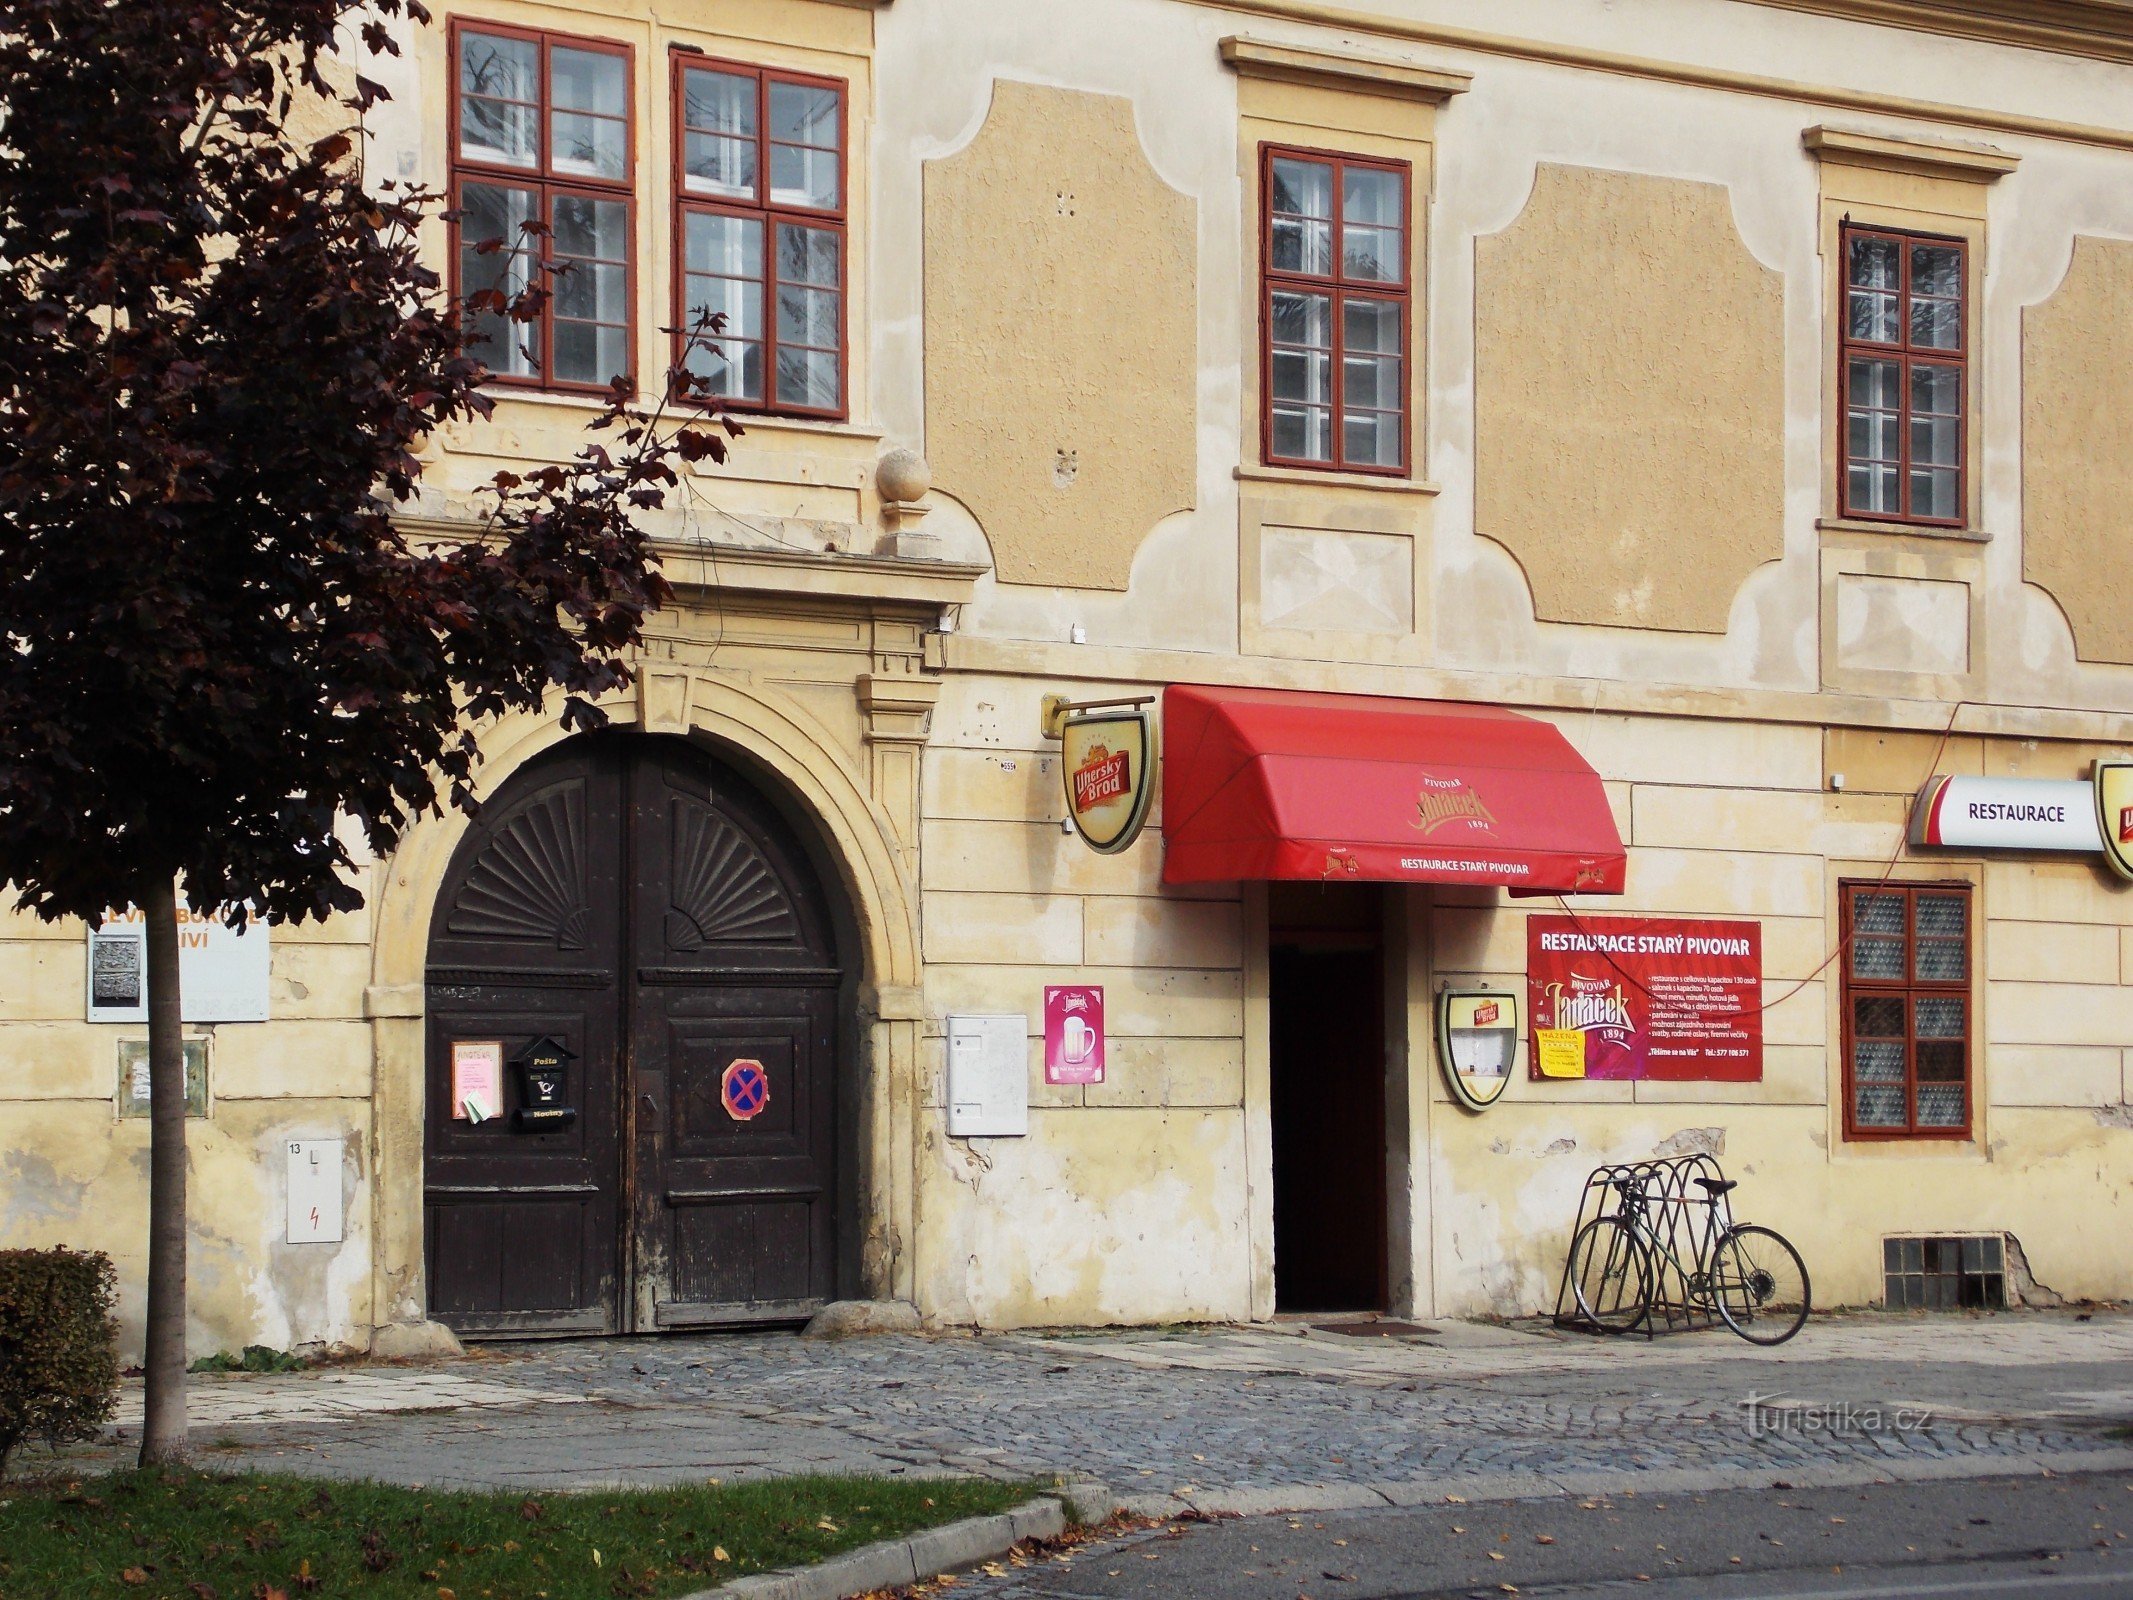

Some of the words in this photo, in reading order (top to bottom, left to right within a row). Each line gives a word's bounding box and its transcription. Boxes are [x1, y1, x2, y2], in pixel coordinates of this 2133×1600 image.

[1076, 758, 1122, 795] Uherský
[1087, 773, 1120, 801] Brod
[1424, 778, 1462, 789] PIVOVAR
[1968, 803, 2065, 823] RESTAURACE
[1467, 820, 1489, 830] 1894
[1401, 858, 1459, 871] RESTAURACE
[1459, 860, 1487, 872] STARÝ
[1489, 862, 1529, 875] PIVOVAR
[1541, 933, 1636, 953] RESTAURACE
[1638, 934, 1684, 954] STARÝ
[1687, 937, 1750, 955] PIVOVAR
[1571, 979, 1611, 992] PIVOVAR
[1603, 1028, 1625, 1040] 1894
[533, 1058, 558, 1066] Pošta
[533, 1109, 563, 1118] Noviny
[289, 1143, 301, 1154] 13
